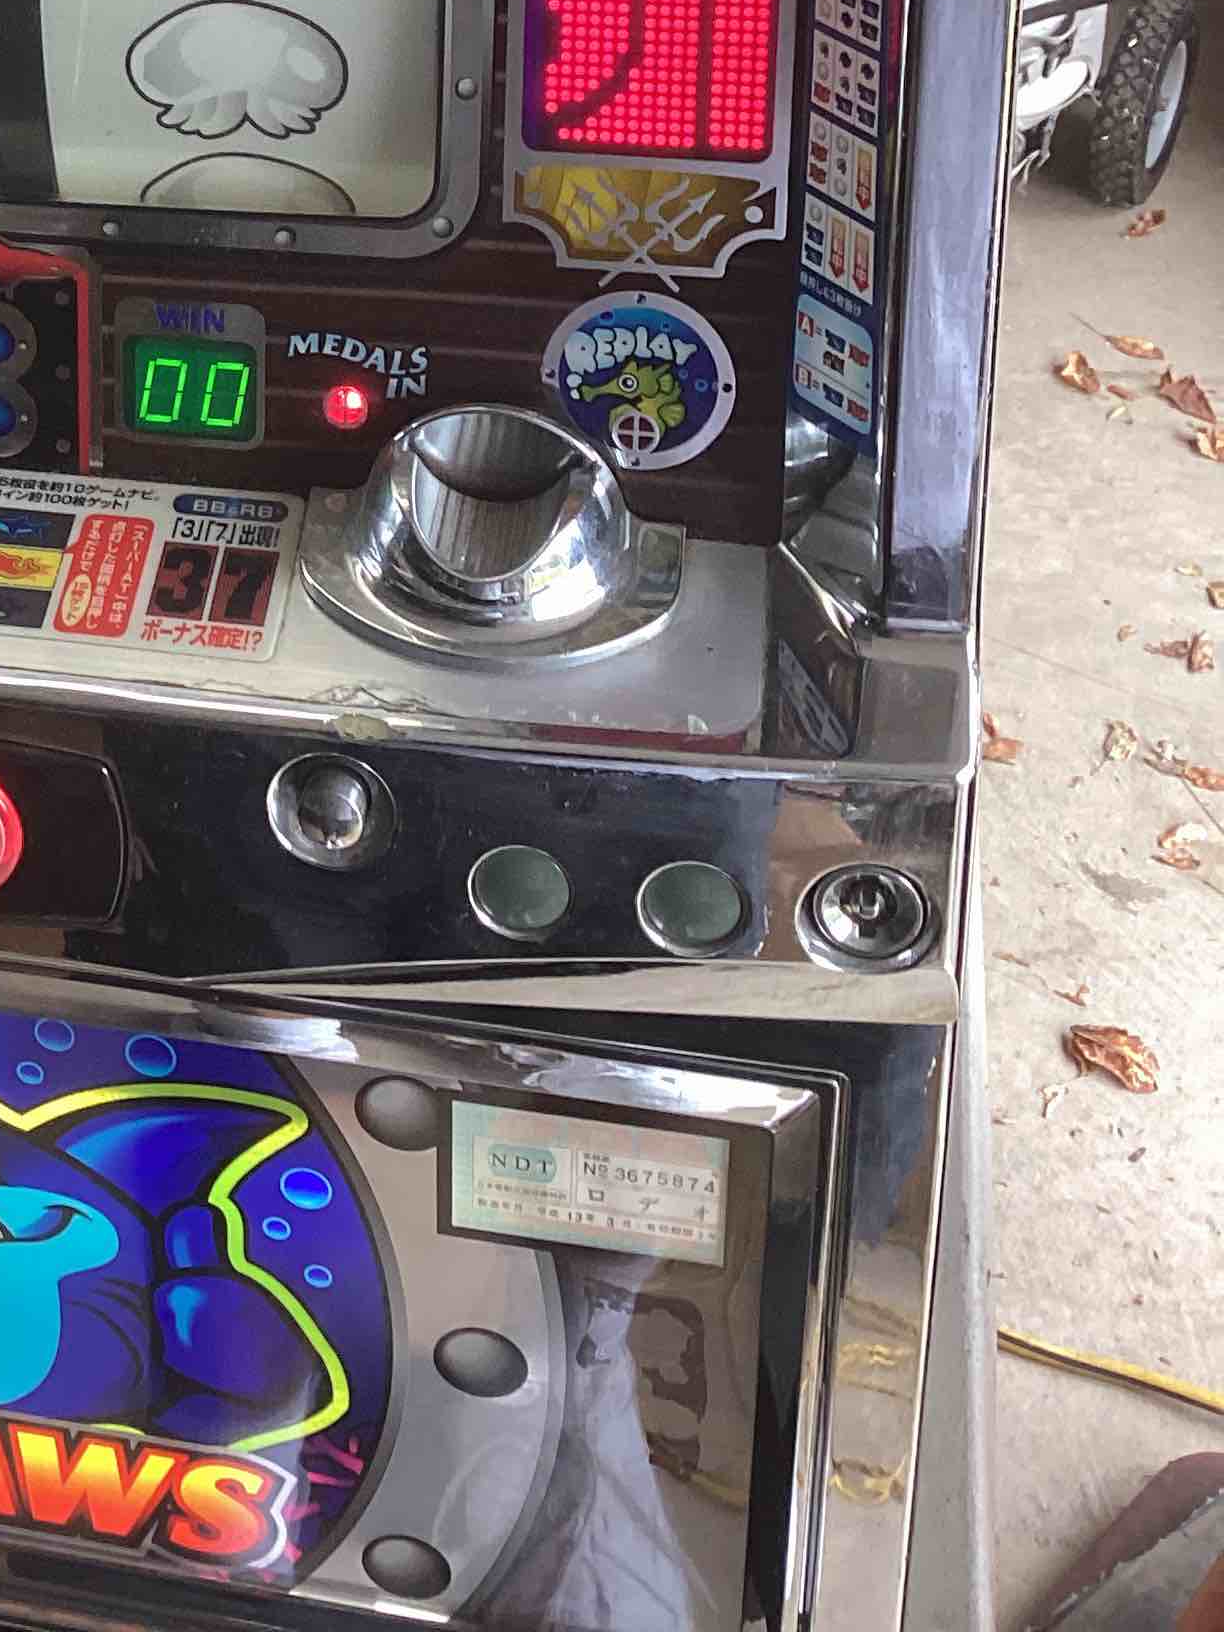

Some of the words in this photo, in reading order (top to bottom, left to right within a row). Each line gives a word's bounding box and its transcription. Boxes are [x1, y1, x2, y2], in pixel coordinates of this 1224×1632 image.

[155, 303, 226, 334] WIN
[288, 332, 428, 375] MEDALS
[139, 358, 249, 427] 00
[385, 375, 427, 399] IN
